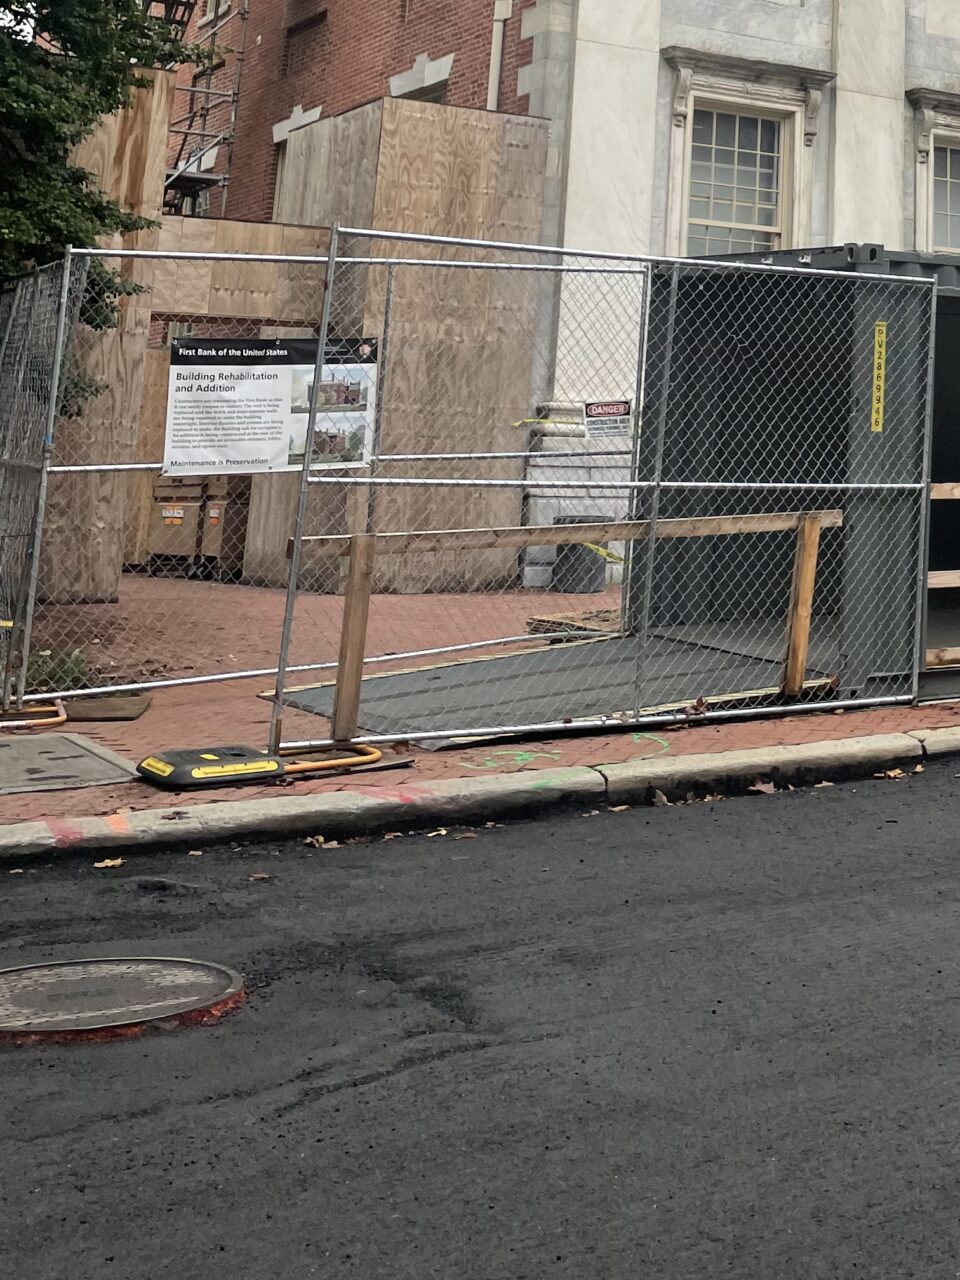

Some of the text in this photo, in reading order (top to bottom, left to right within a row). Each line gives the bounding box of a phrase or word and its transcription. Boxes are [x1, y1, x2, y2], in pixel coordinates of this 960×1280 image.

[179, 348, 288, 357] First Bank of the United States
[176, 371, 279, 383] Building Rehabilitation
[175, 384, 236, 393] and Addition
[591, 405, 625, 414] DANGER
[170, 458, 269, 468] Maintenance is Preservation
